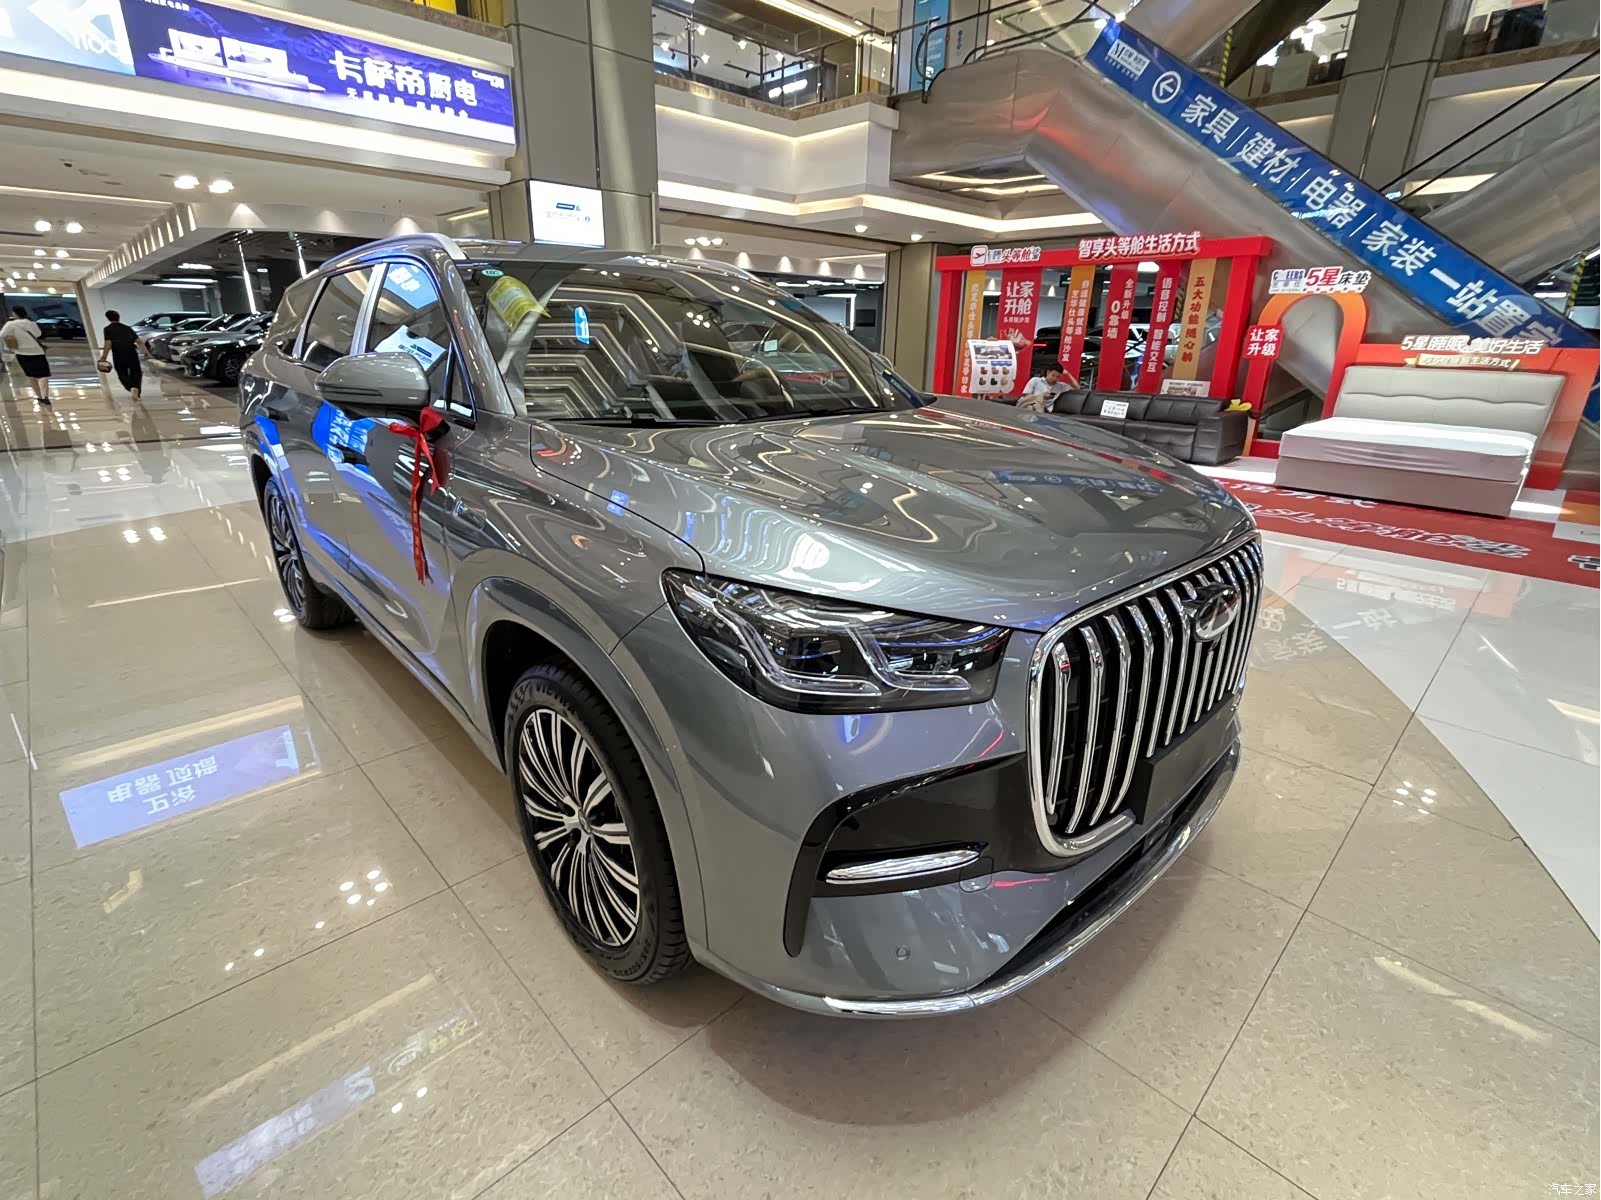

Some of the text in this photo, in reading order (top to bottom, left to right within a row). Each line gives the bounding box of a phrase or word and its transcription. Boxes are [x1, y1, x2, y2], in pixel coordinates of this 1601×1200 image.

[328, 50, 478, 106] 卡萨帝厨电
[1180, 94, 1240, 144] 家具
[1236, 132, 1302, 184] 建材
[1301, 176, 1367, 229] 电器
[1078, 232, 1201, 260] 智享头等舱生活方式
[1305, 268, 1369, 287] 5星床垫
[1006, 281, 1035, 298] 让家
[1003, 297, 1032, 315] 升舱
[1181, 276, 1206, 363] 五大功能随心躺
[1250, 328, 1280, 342] 让家
[1246, 342, 1277, 357] 升级
